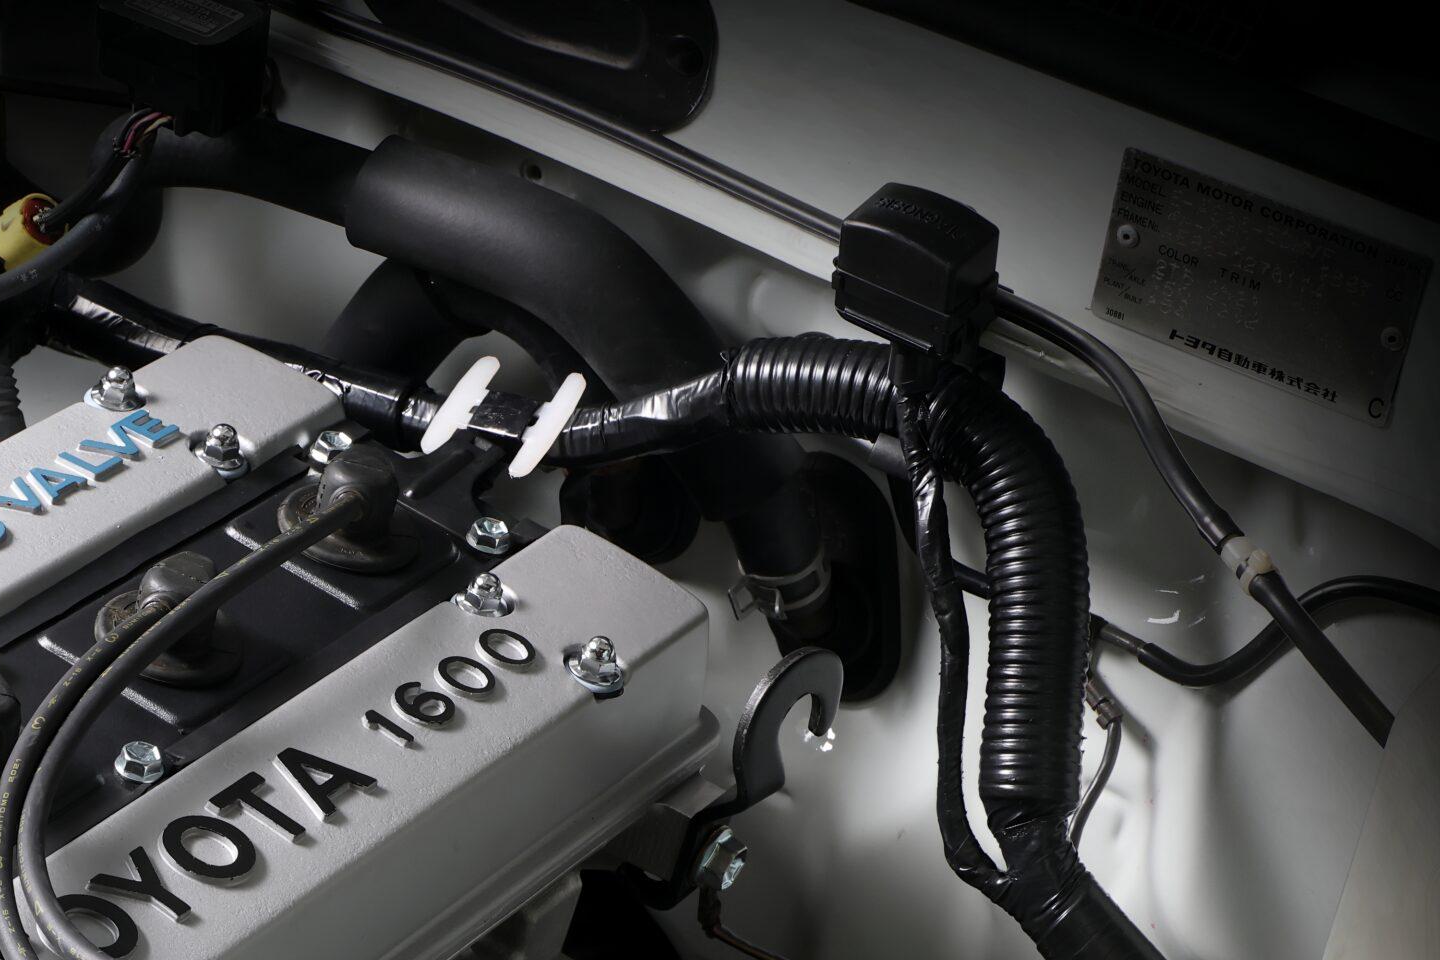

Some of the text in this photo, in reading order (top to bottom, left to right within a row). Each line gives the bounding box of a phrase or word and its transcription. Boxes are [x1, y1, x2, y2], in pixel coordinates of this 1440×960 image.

[1124, 173, 1167, 198] MODEL
[1119, 191, 1164, 216] ENGINE
[1132, 157, 1190, 189] TOYOTA
[1196, 181, 1255, 213] MOTOR
[1260, 206, 1379, 259] CORPORATION
[1158, 244, 1200, 268] COLOR
[1219, 266, 1262, 290] TRIM
[1169, 328, 1338, 403] トヨタ自動車株式会社
[1368, 397, 1384, 419] C
[363, 628, 537, 748] 1600
[8, 758, 22, 782] 2021
[31, 716, 46, 730] 3
